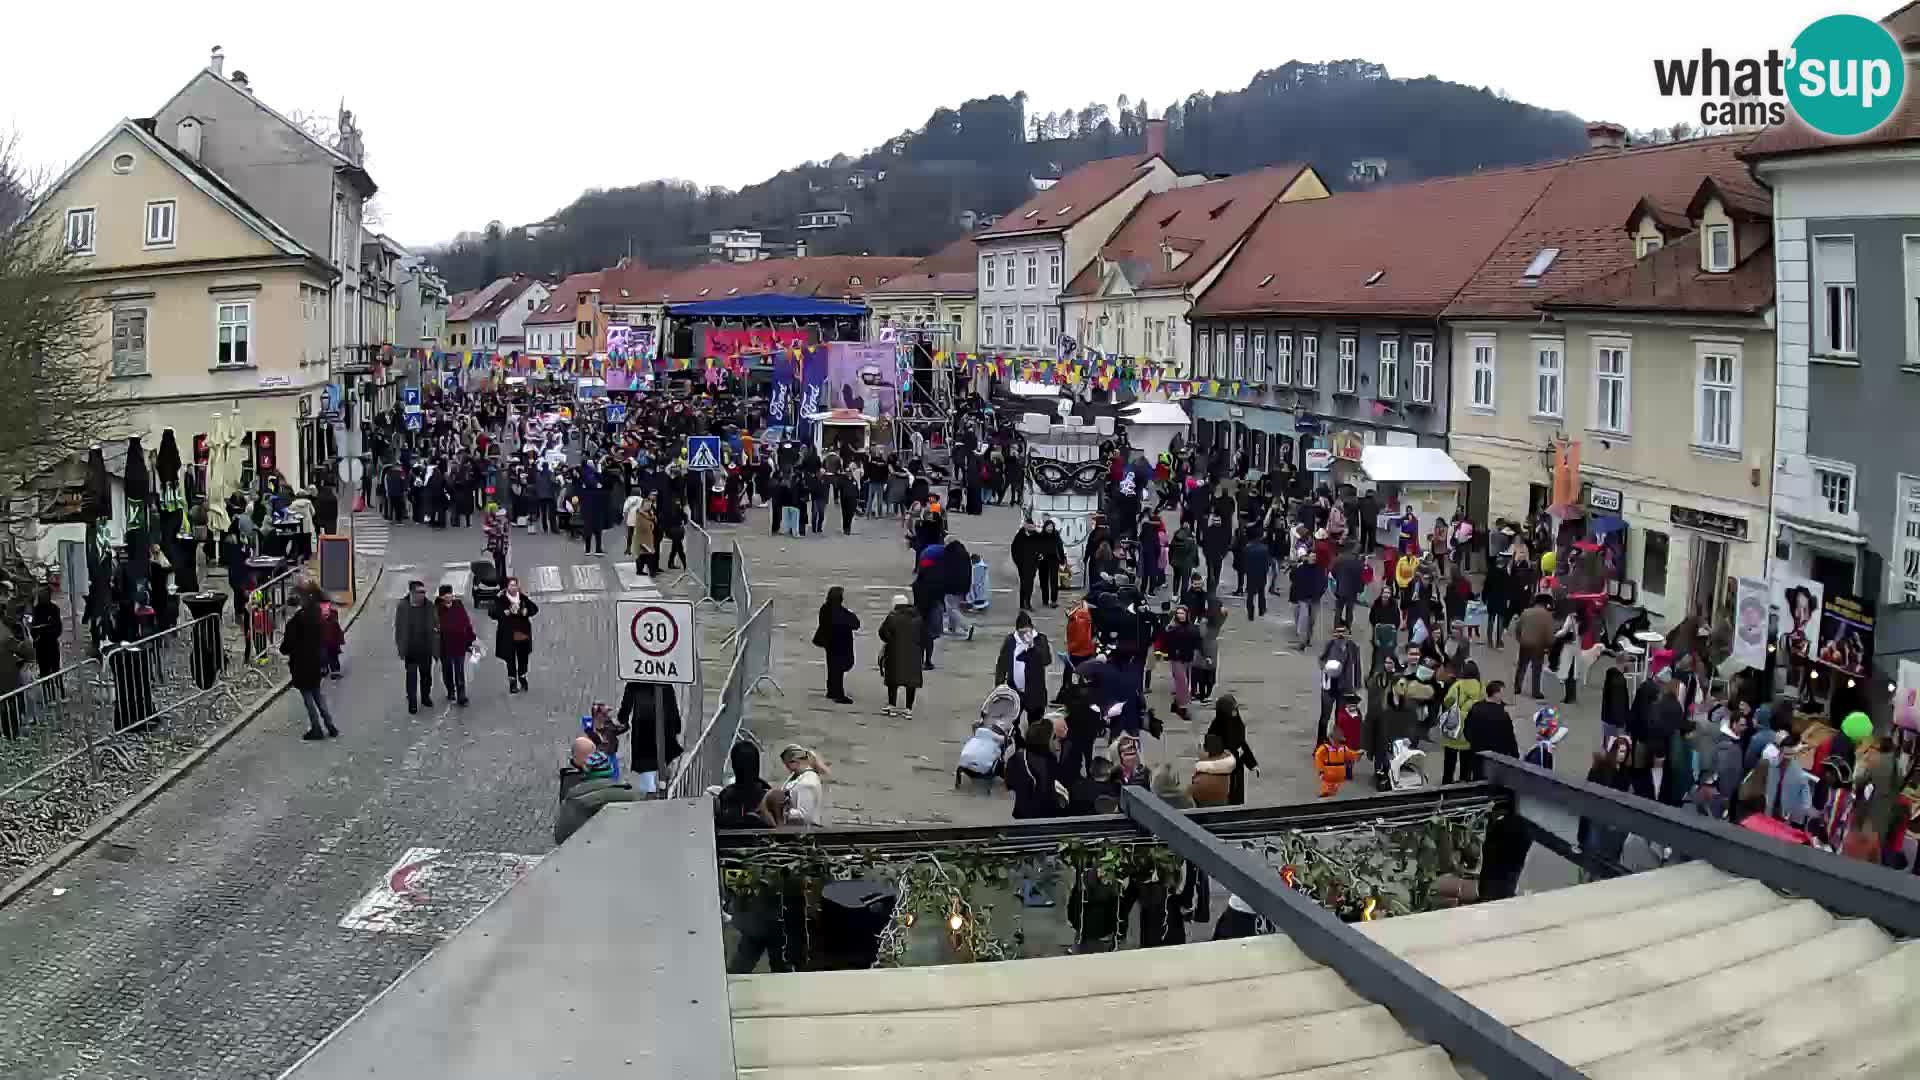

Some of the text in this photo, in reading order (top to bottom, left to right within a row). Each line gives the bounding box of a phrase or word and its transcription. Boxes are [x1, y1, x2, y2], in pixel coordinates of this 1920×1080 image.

[408, 391, 416, 403] P
[643, 622, 668, 643] 30
[633, 659, 679, 677] ZONA
